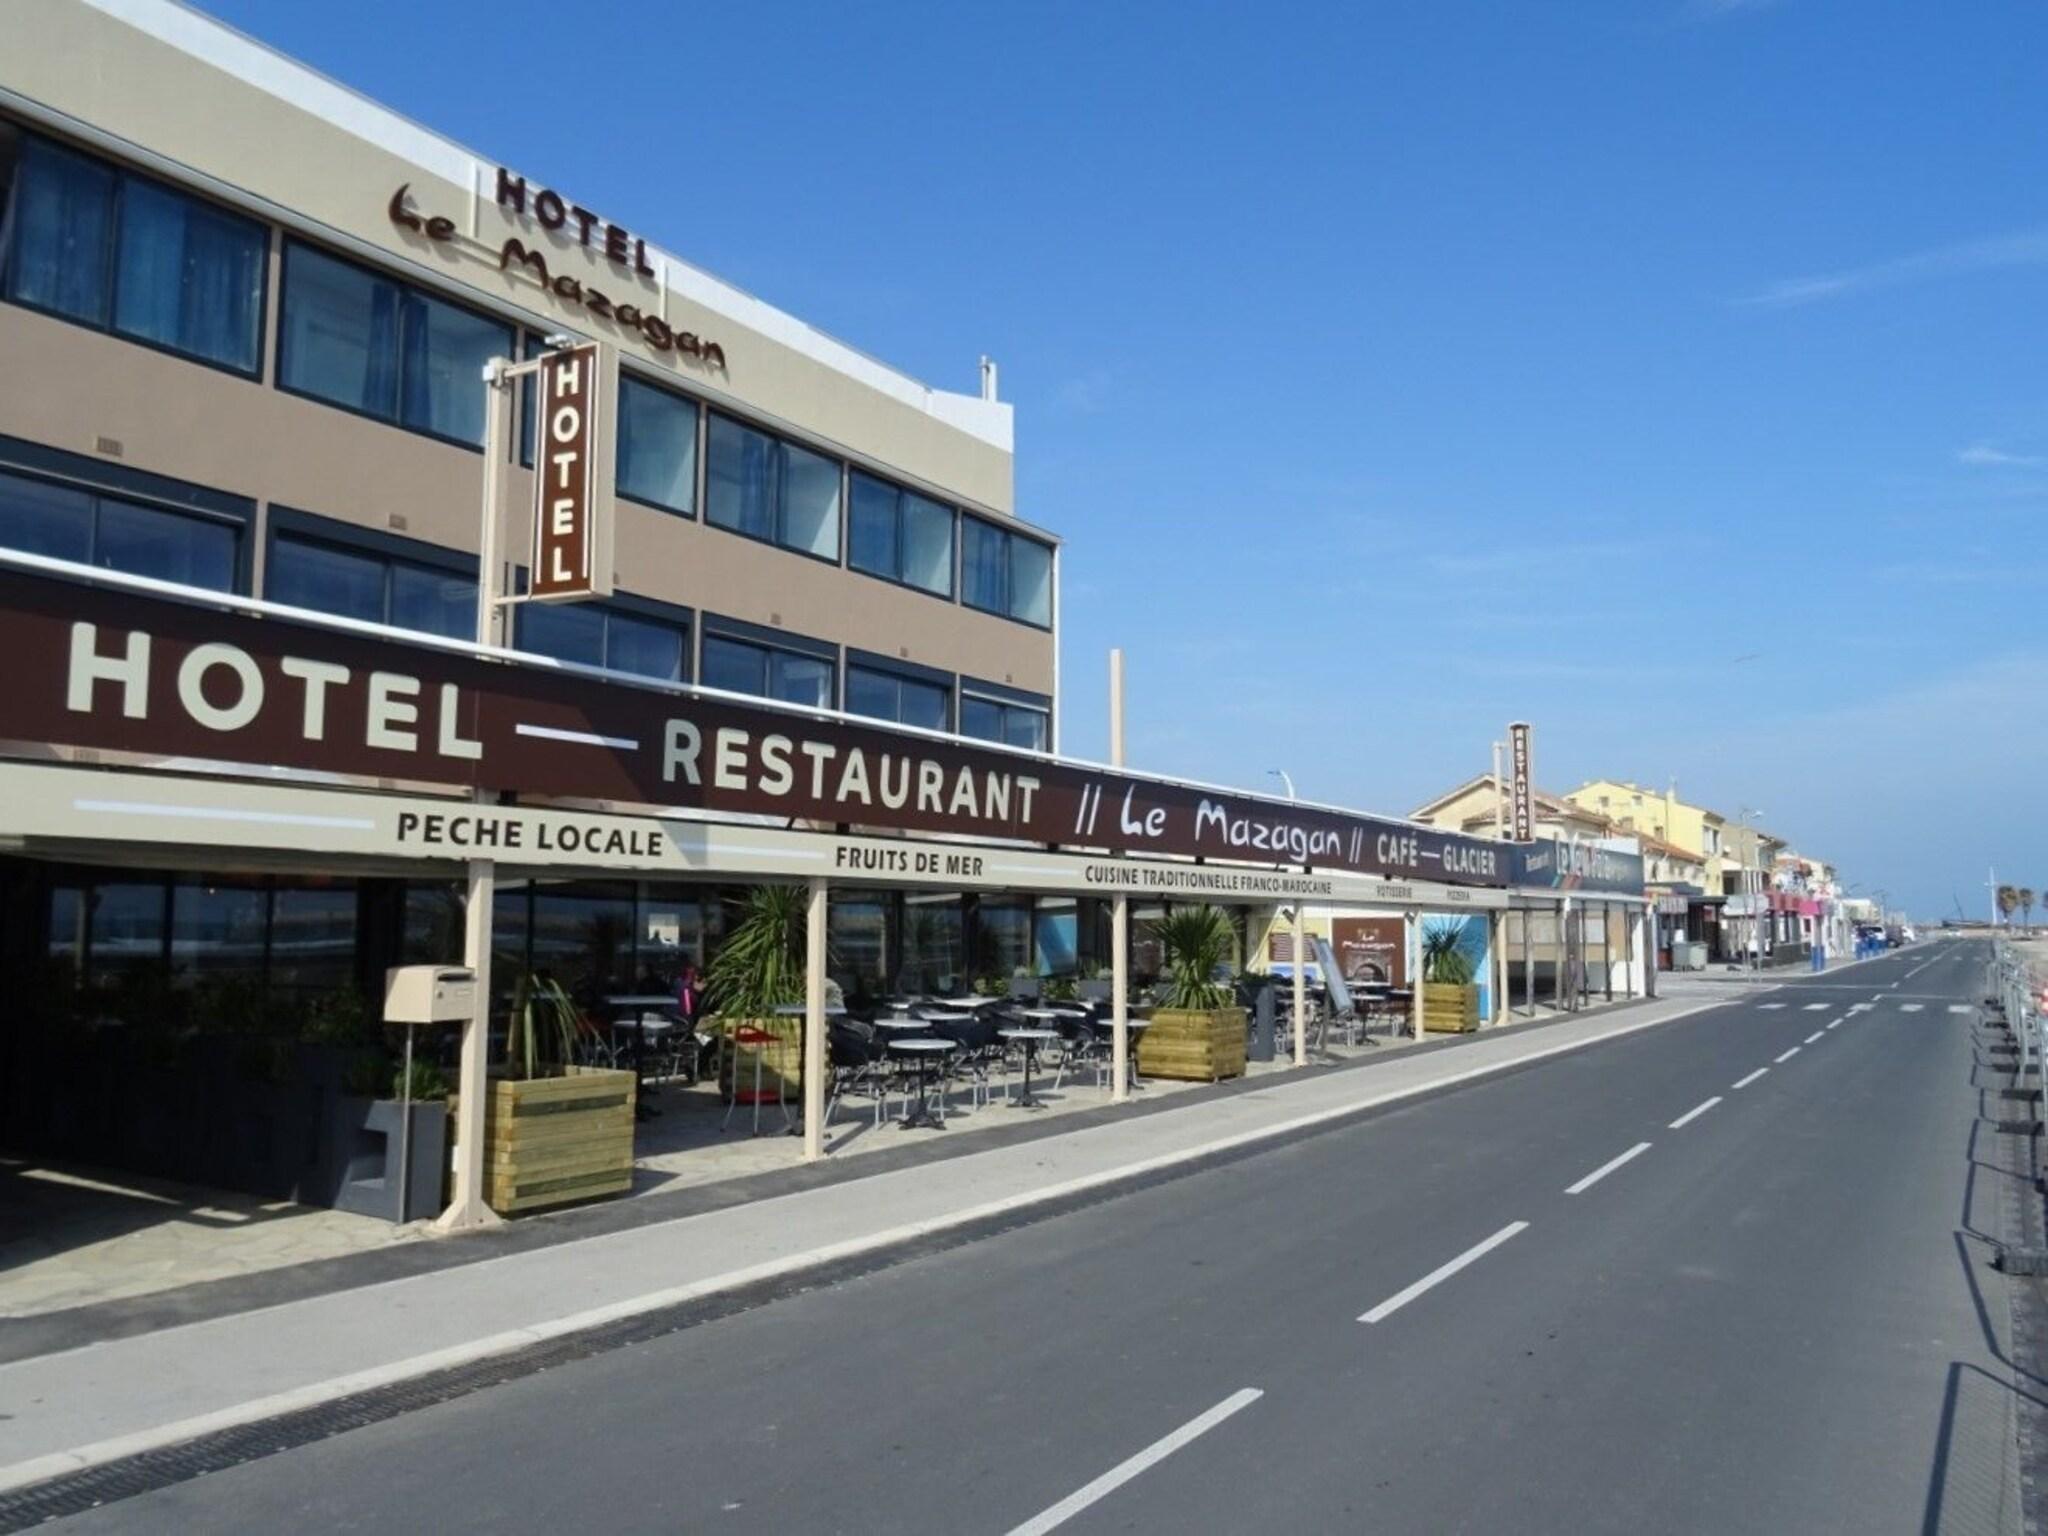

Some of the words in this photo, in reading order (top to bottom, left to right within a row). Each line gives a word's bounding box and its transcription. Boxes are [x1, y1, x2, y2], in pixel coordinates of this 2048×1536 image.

[389, 182, 455, 241] Le
[500, 238, 726, 370] Mazagan
[497, 167, 655, 278] HOTEL
[553, 359, 580, 582] HOTEL
[66, 621, 483, 759] HOTEL
[663, 718, 1040, 823] RESTAURANT
[1120, 782, 1167, 837] Le
[1195, 799, 1341, 862] Mazagan
[1377, 831, 1418, 867] CAFÉ
[1442, 843, 1497, 876] GLACIER
[1514, 727, 1526, 838] RESTAURANT
[397, 812, 523, 849] PECHE
[537, 824, 663, 857] LOCALE
[836, 846, 908, 872] FRUITS
[916, 852, 939, 874] DE
[946, 855, 983, 877] MER
[1085, 865, 1138, 884] CUISINE
[1142, 869, 1239, 890] TRADITIONNELLE
[1240, 876, 1332, 895] FRANCO-MAROCAINE
